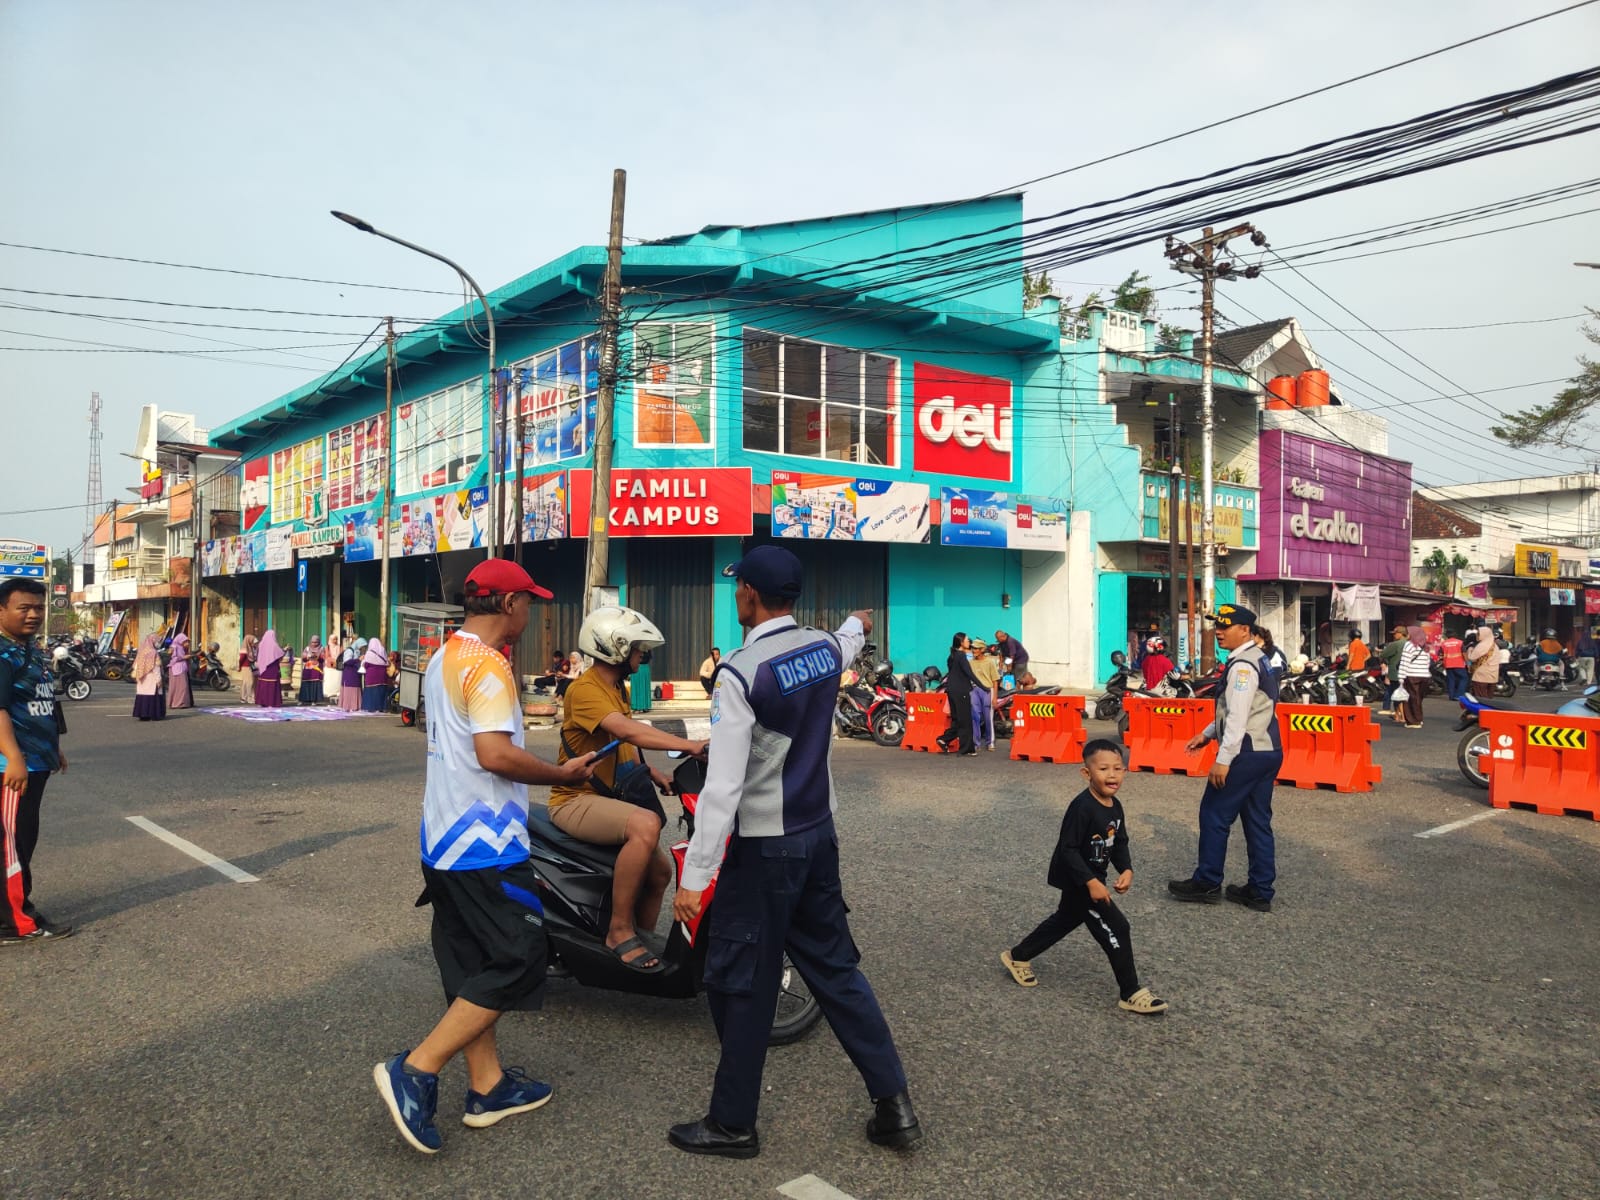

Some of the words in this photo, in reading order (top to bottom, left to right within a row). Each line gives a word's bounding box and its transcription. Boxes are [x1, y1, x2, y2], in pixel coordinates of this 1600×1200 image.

[919, 395, 1011, 453] deli
[774, 472, 790, 481] deli
[615, 478, 707, 498] FAMILI
[858, 481, 876, 491] deli
[608, 506, 719, 526] KAMPUS
[952, 507, 967, 516] deli
[1018, 512, 1031, 521] deli
[312, 528, 340, 544] KAMPUS
[777, 648, 836, 689] DISHUB
